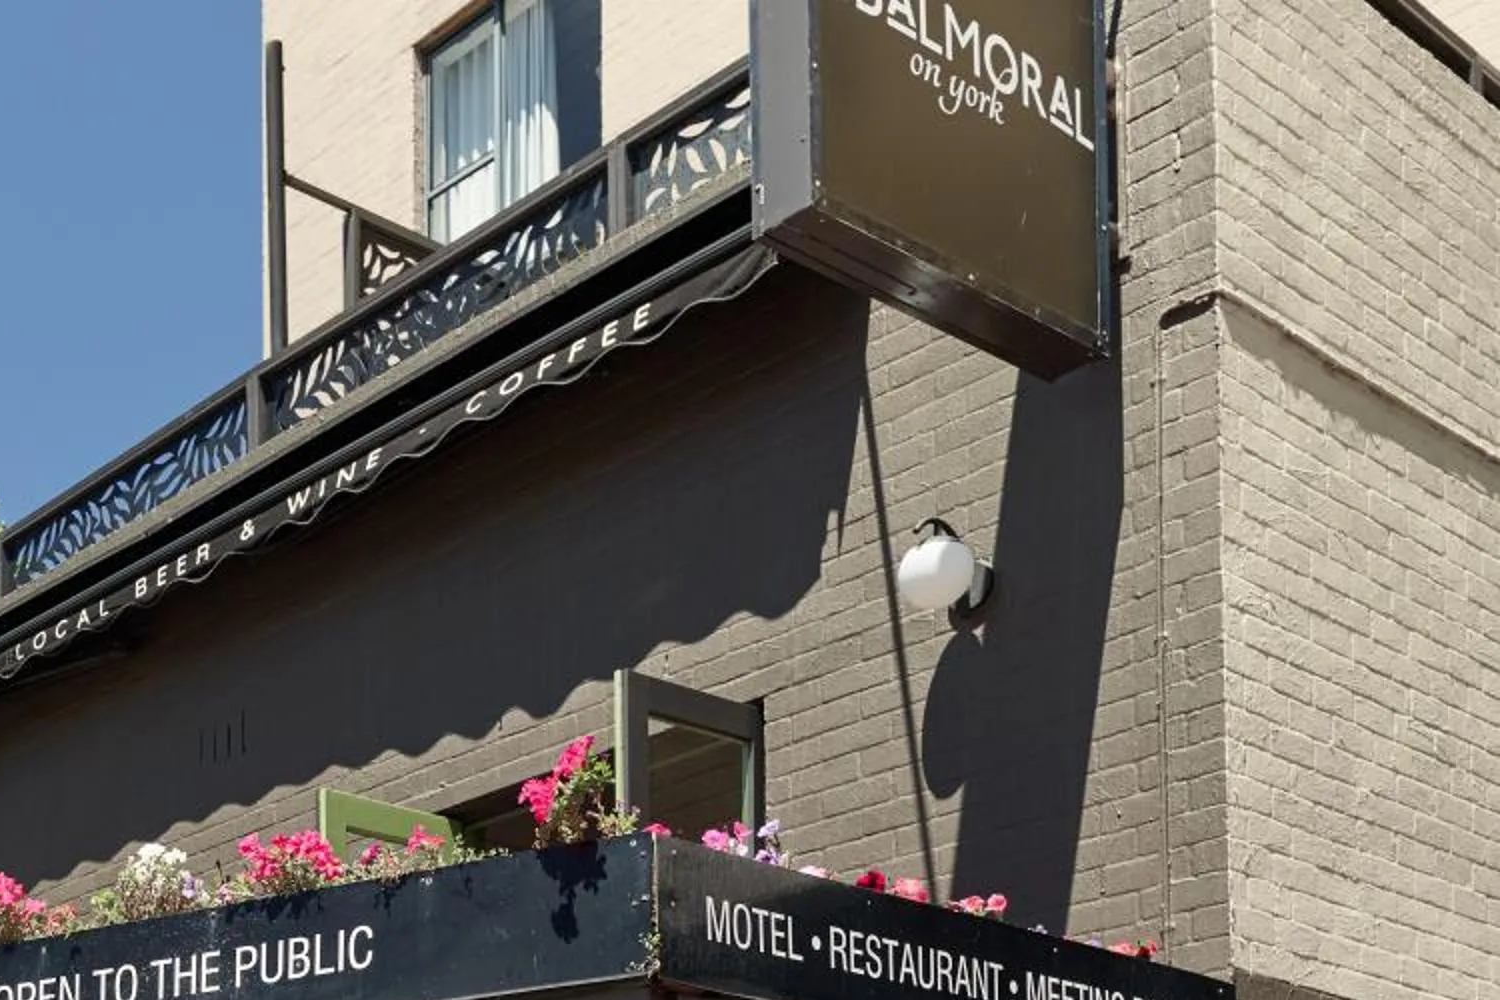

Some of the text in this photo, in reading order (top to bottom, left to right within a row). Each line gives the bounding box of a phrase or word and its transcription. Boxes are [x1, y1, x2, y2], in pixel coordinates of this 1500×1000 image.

[855, 0, 1095, 151] ALMORAL
[909, 53, 1005, 124] on york
[15, 600, 109, 660] LOCAL
[135, 543, 210, 599] BEER
[239, 518, 256, 541] &
[286, 447, 383, 515] WINE
[464, 302, 652, 415] COFFEE
[151, 950, 221, 1000] THE
[235, 925, 374, 989] PUBLIC
[705, 895, 803, 962] MOTEL
